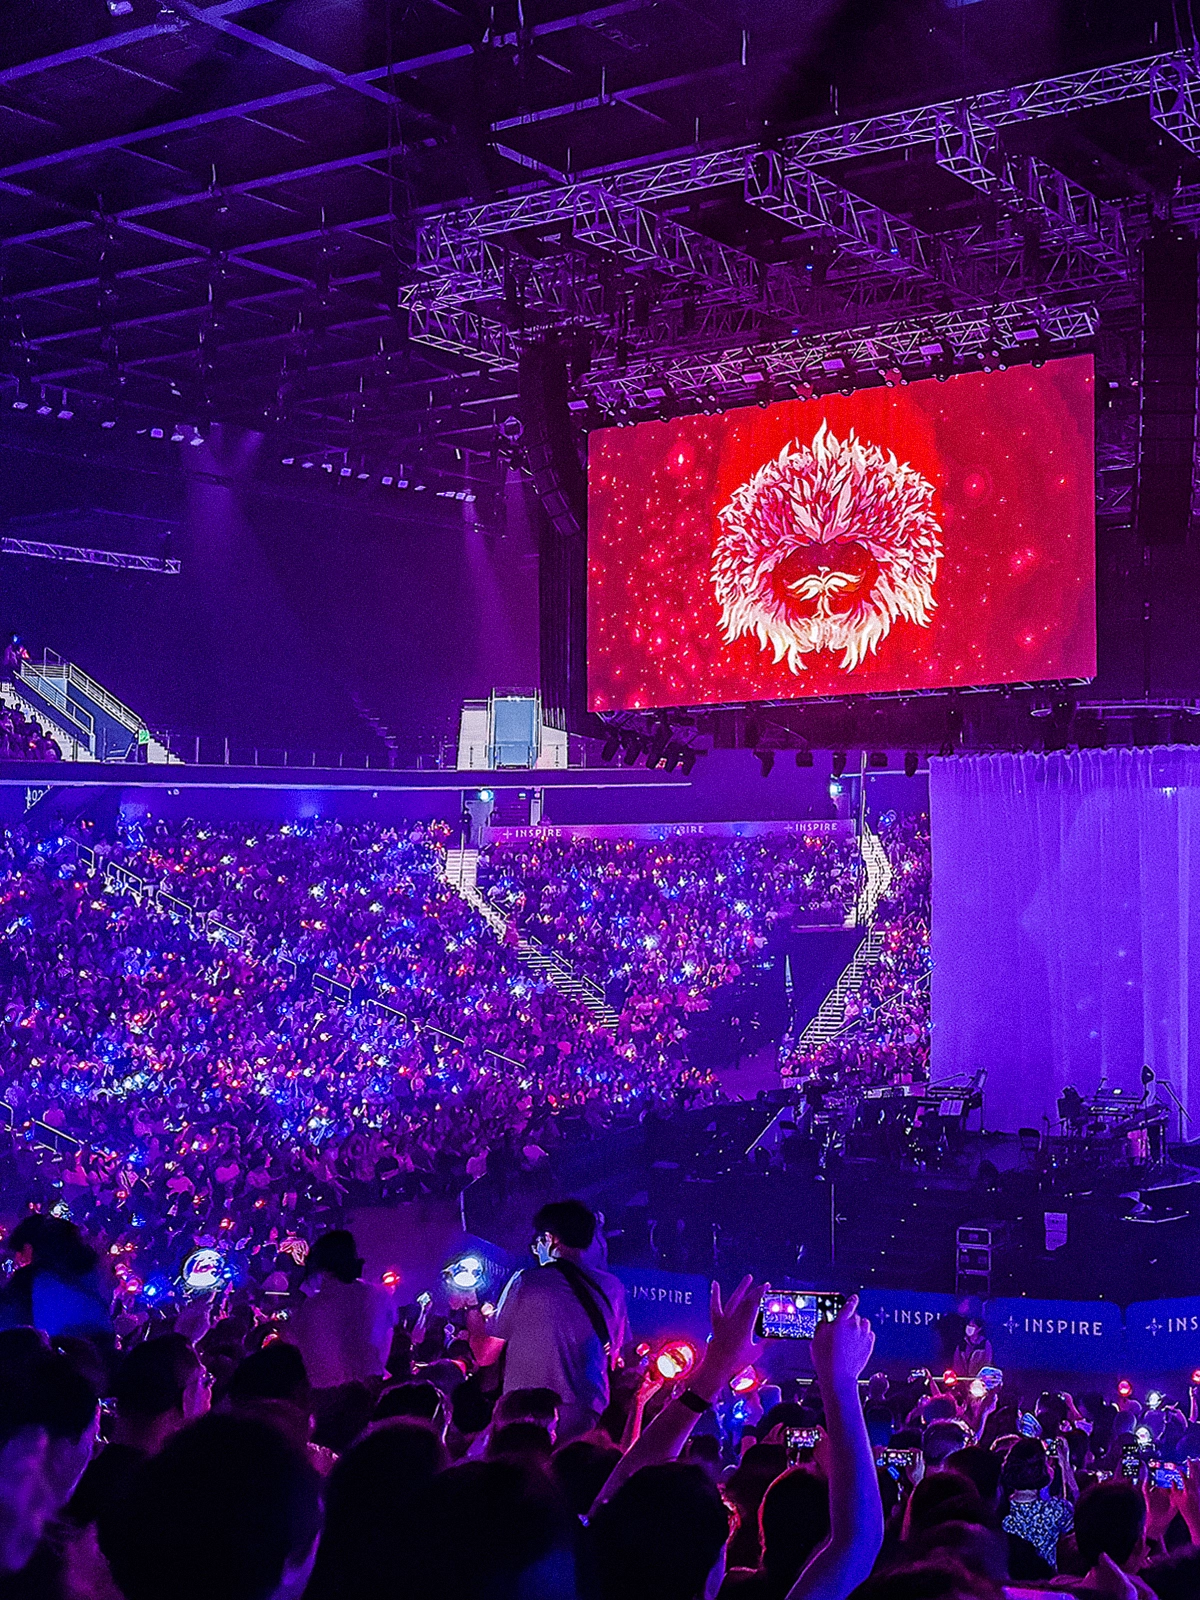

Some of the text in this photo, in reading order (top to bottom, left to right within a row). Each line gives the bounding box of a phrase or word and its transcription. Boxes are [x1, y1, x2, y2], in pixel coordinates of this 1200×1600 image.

[515, 829, 562, 838] INSPIRE
[795, 822, 838, 832] INSPIRE
[633, 1285, 693, 1305] INSPIRE
[894, 1309, 941, 1326] INSPI
[1025, 1318, 1103, 1336] INSPIRE
